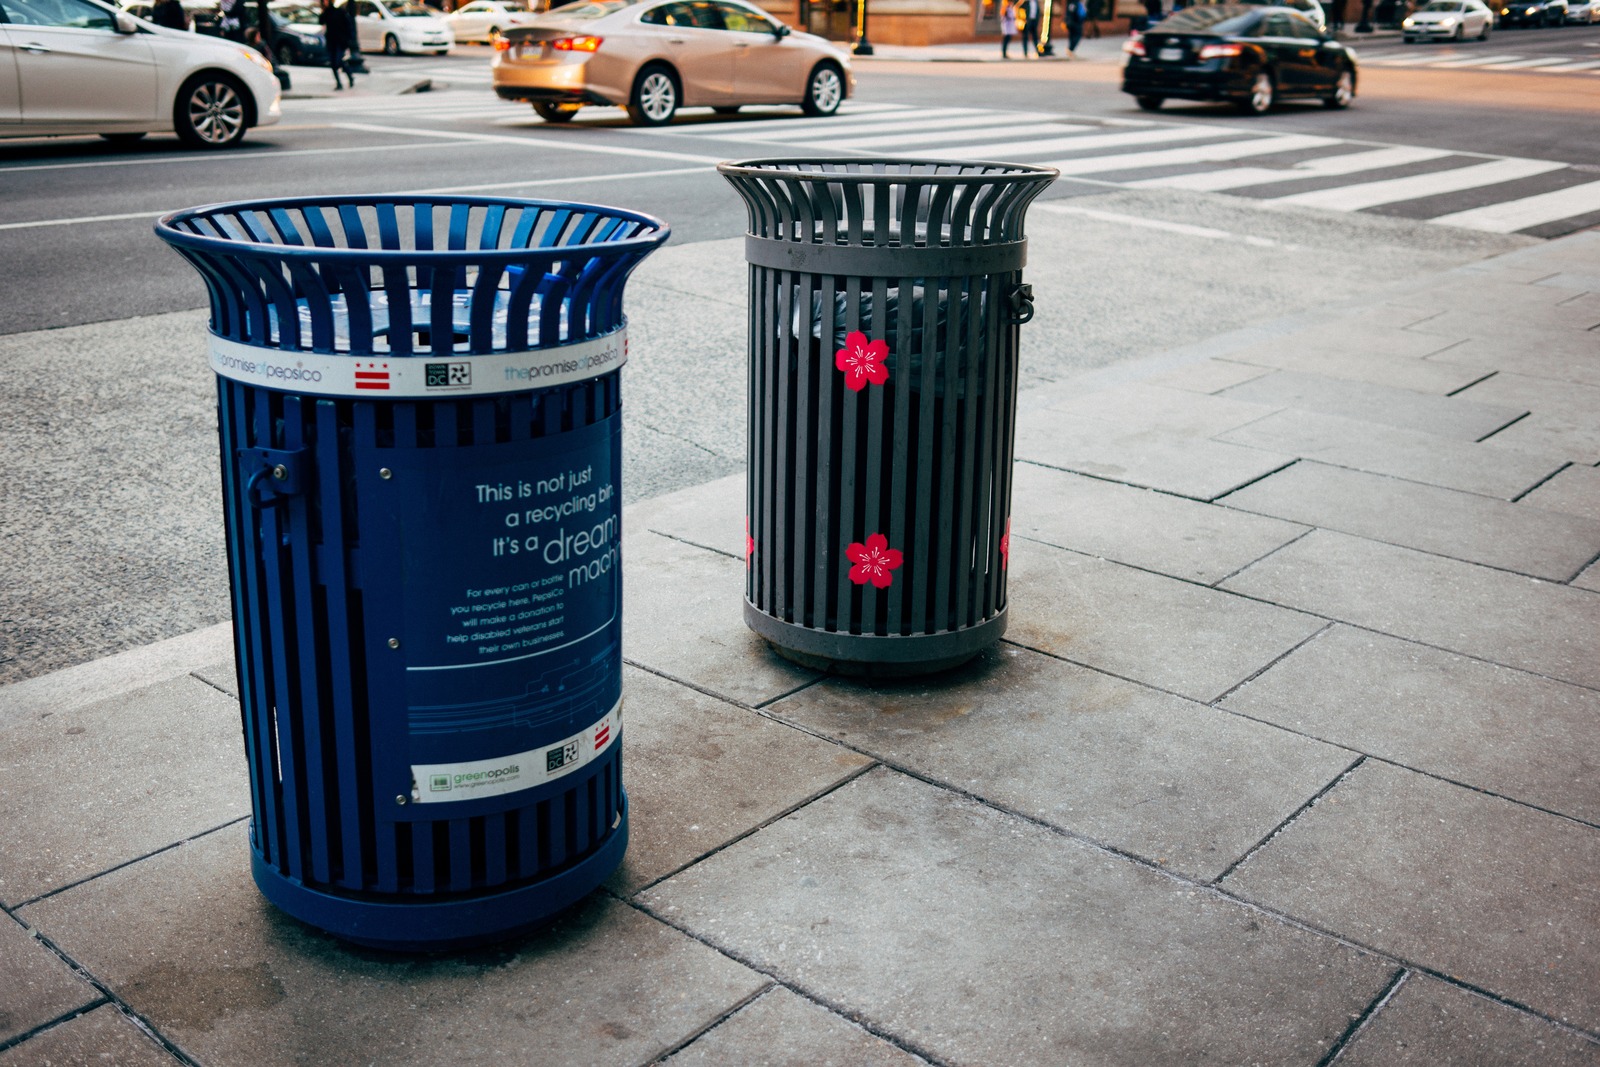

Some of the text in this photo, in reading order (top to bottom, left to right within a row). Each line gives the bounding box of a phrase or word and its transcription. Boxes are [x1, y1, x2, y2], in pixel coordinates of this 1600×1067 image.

[428, 375, 447, 385] DC
[476, 465, 592, 502] This is not just
[505, 513, 520, 527] a
[526, 493, 596, 524] recycling
[493, 514, 618, 564] It's a dream
[466, 574, 564, 598] For every can or bottle
[450, 606, 469, 616] you
[471, 601, 507, 613] recycle
[532, 588, 564, 603] PepsiCo
[462, 618, 478, 627] will
[480, 615, 507, 625] make
[517, 605, 555, 620] donation
[556, 602, 564, 610] to
[446, 616, 564, 643] help disabled veterans start
[479, 630, 565, 654] their own businesses
[453, 764, 520, 784] greenopolis
[548, 757, 563, 770] DC
